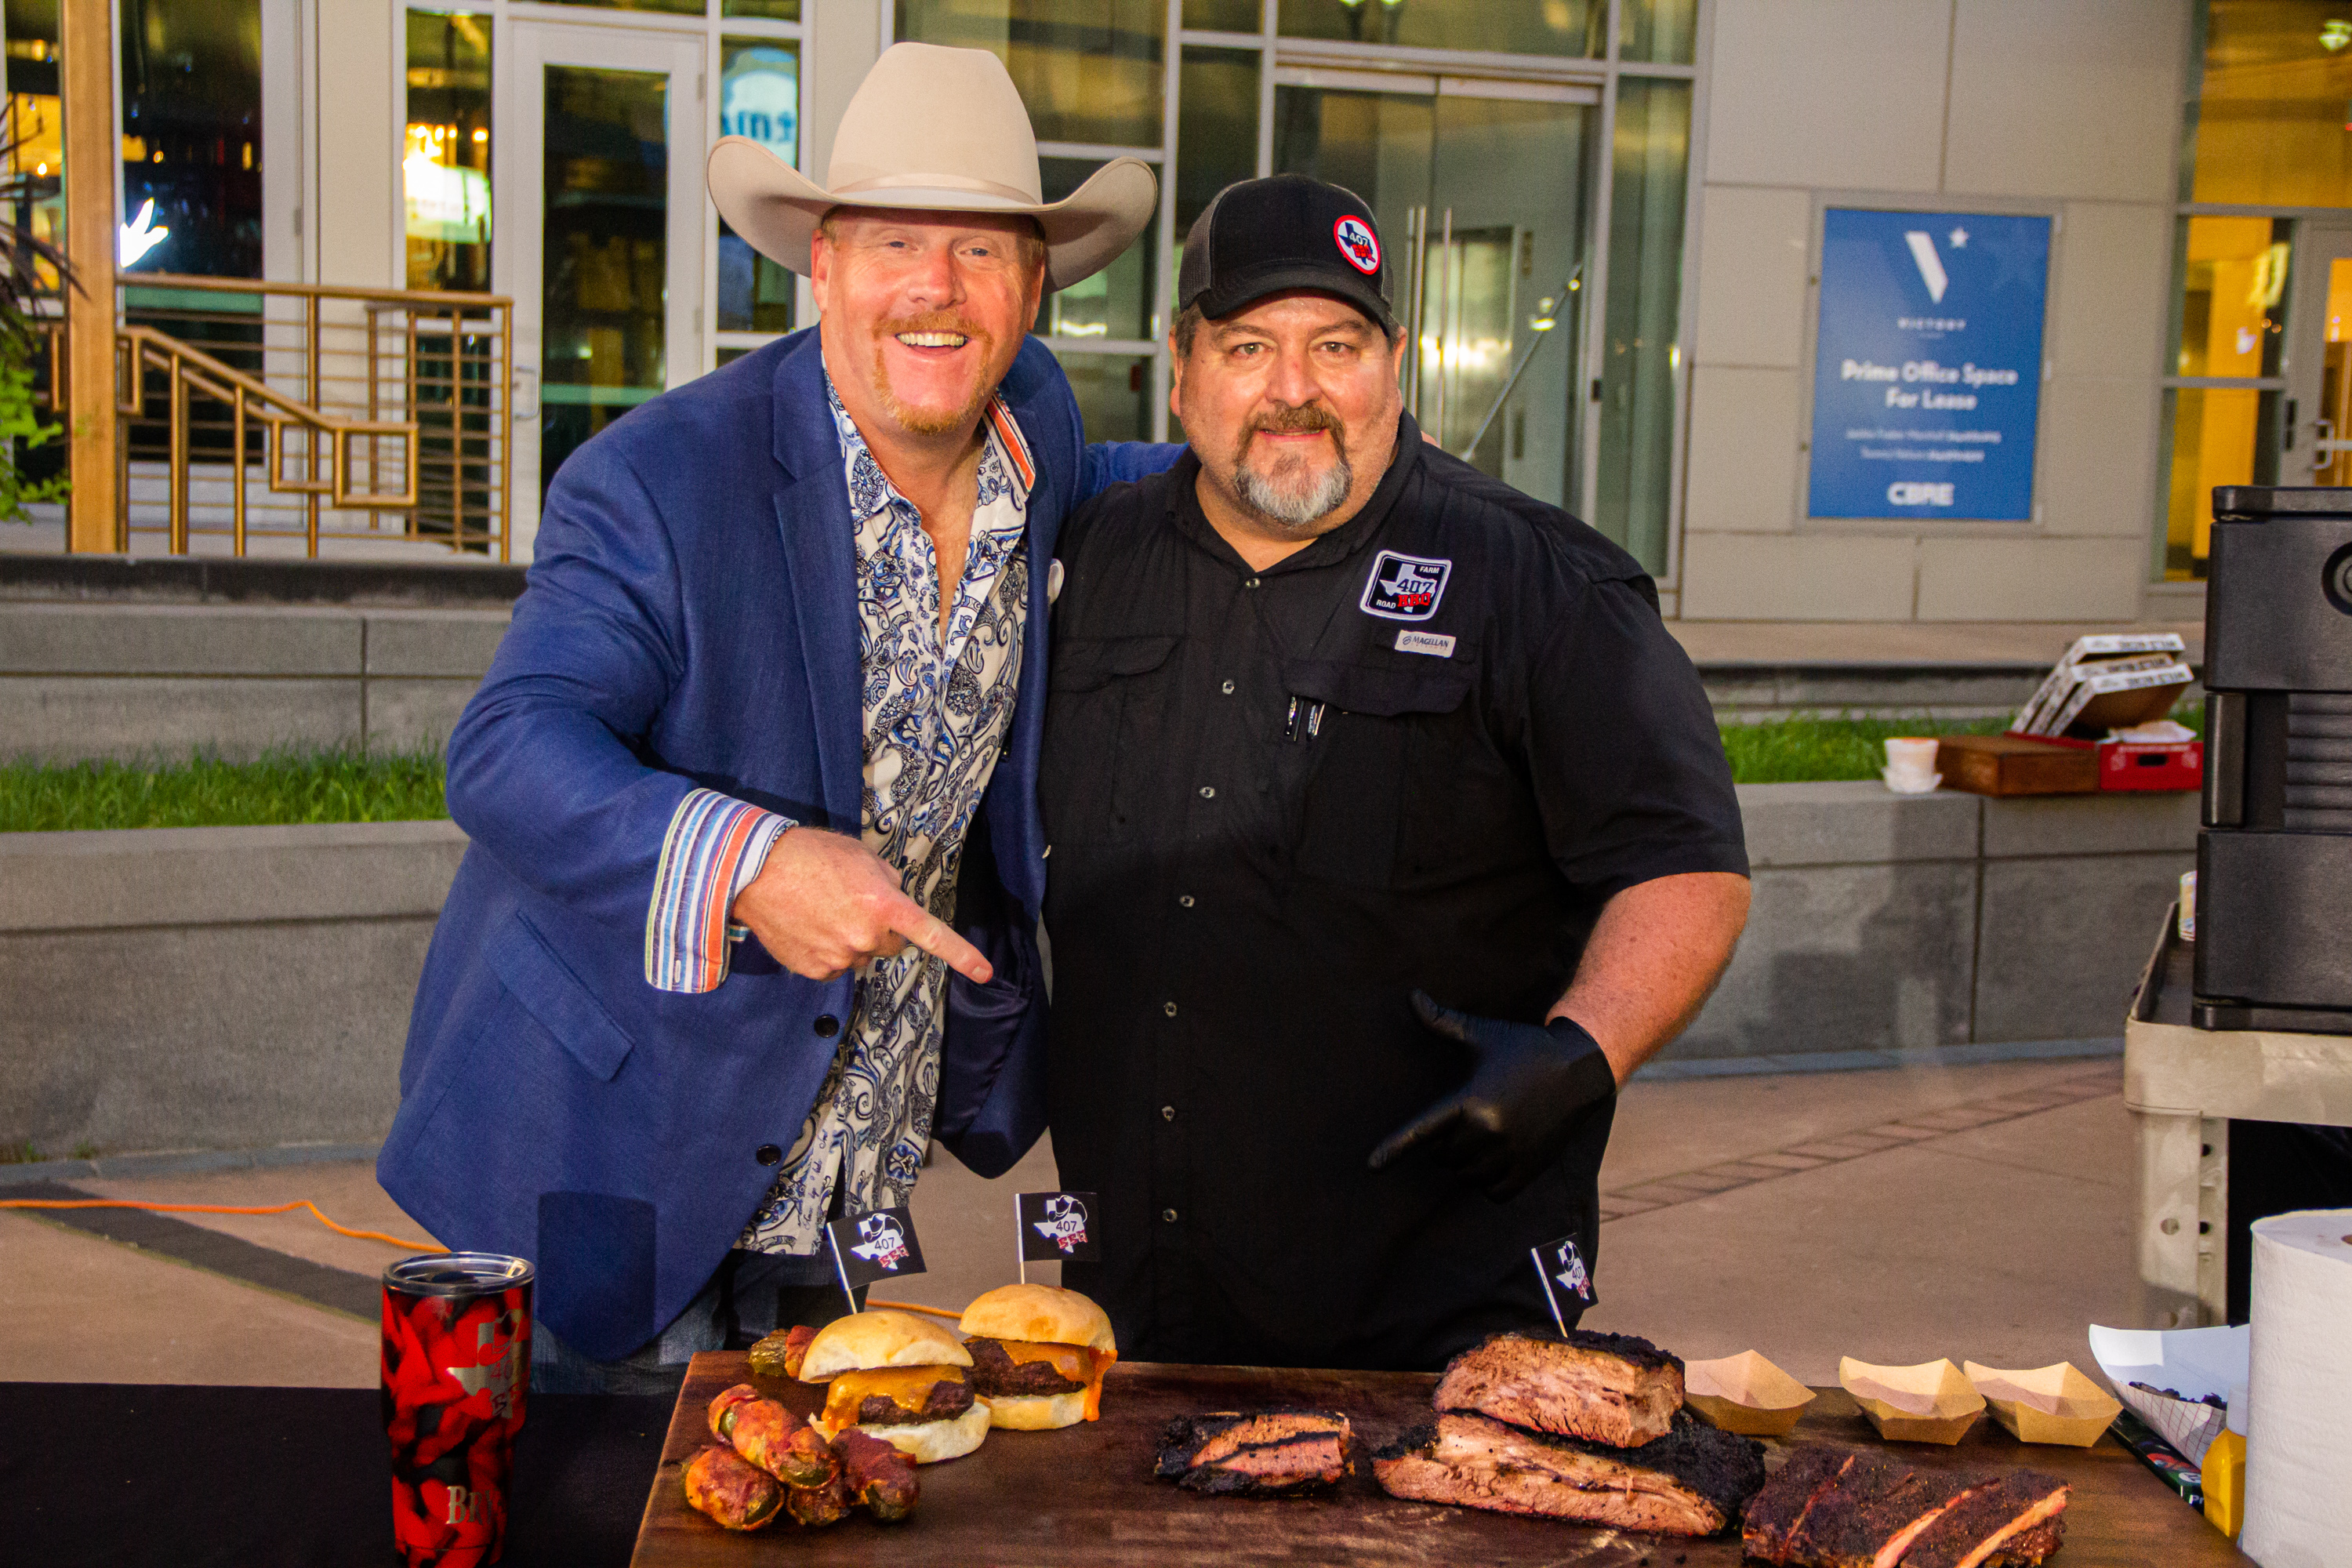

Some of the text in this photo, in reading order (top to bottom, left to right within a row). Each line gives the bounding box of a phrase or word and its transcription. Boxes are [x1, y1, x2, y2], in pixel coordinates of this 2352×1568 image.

[1348, 232, 1368, 245] 407
[1841, 359, 2019, 388] Prime Office Space
[1886, 386, 1977, 410] For Lease
[1887, 481, 1955, 506] CBRE
[1397, 579, 1434, 593] 407
[1376, 599, 1396, 609] ROAD
[1397, 592, 1432, 607] BBQ
[1412, 636, 1449, 648] MAGELLAN
[1055, 1221, 1077, 1232] 407
[874, 1237, 895, 1250] 407
[1572, 1265, 1583, 1279] 407
